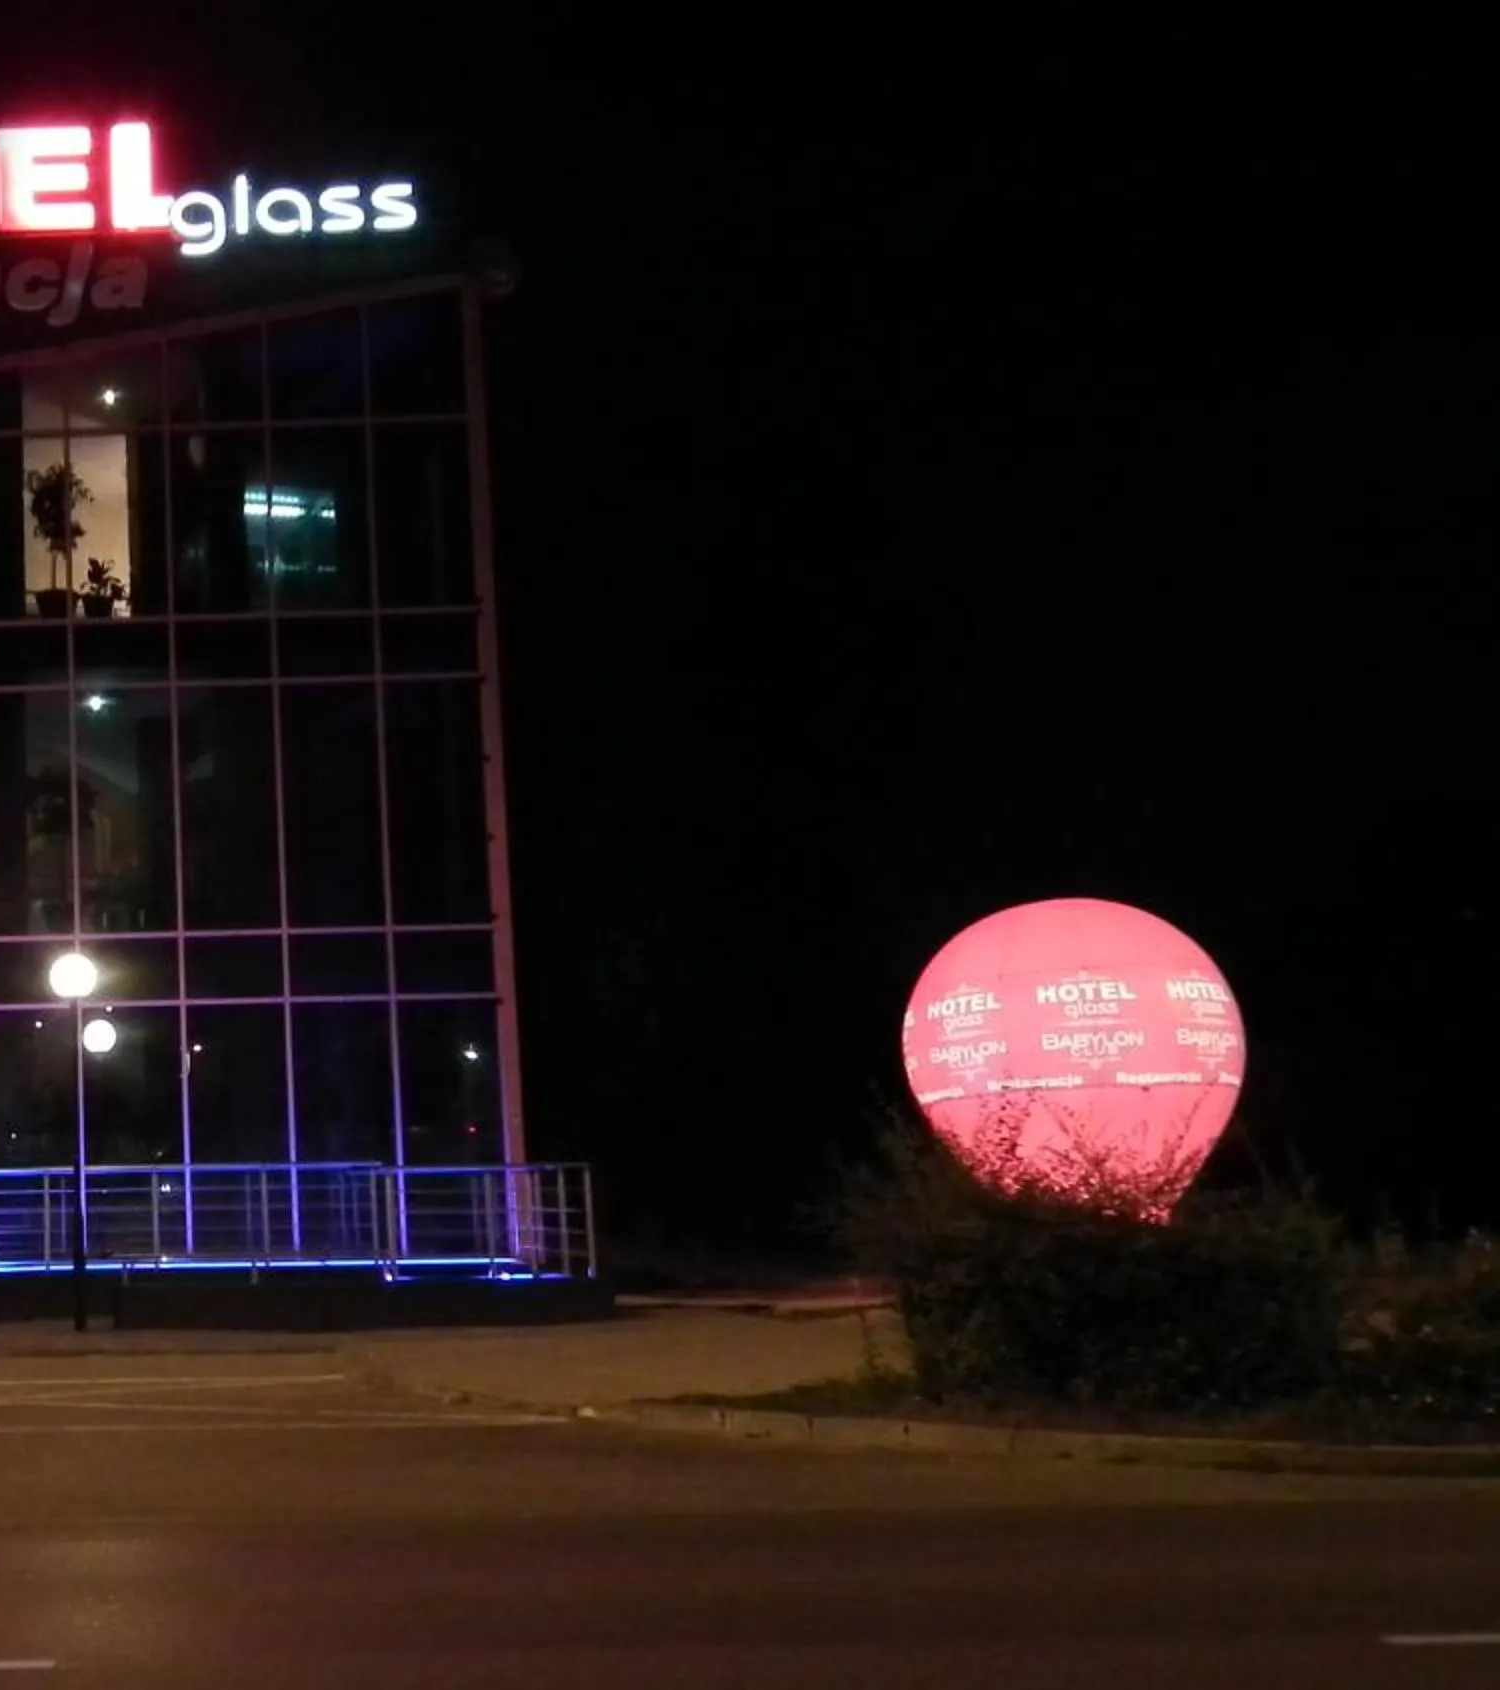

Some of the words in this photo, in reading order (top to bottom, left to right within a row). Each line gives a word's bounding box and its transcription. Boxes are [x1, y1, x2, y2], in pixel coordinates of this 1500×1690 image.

[168, 173, 419, 257] glass
[1035, 980, 1138, 1005] HOTEL
[926, 991, 1003, 1020] HOTEL
[1062, 1000, 1121, 1020] glass
[928, 1039, 1008, 1065] BABYLON
[1040, 1030, 1146, 1051] BABYLON
